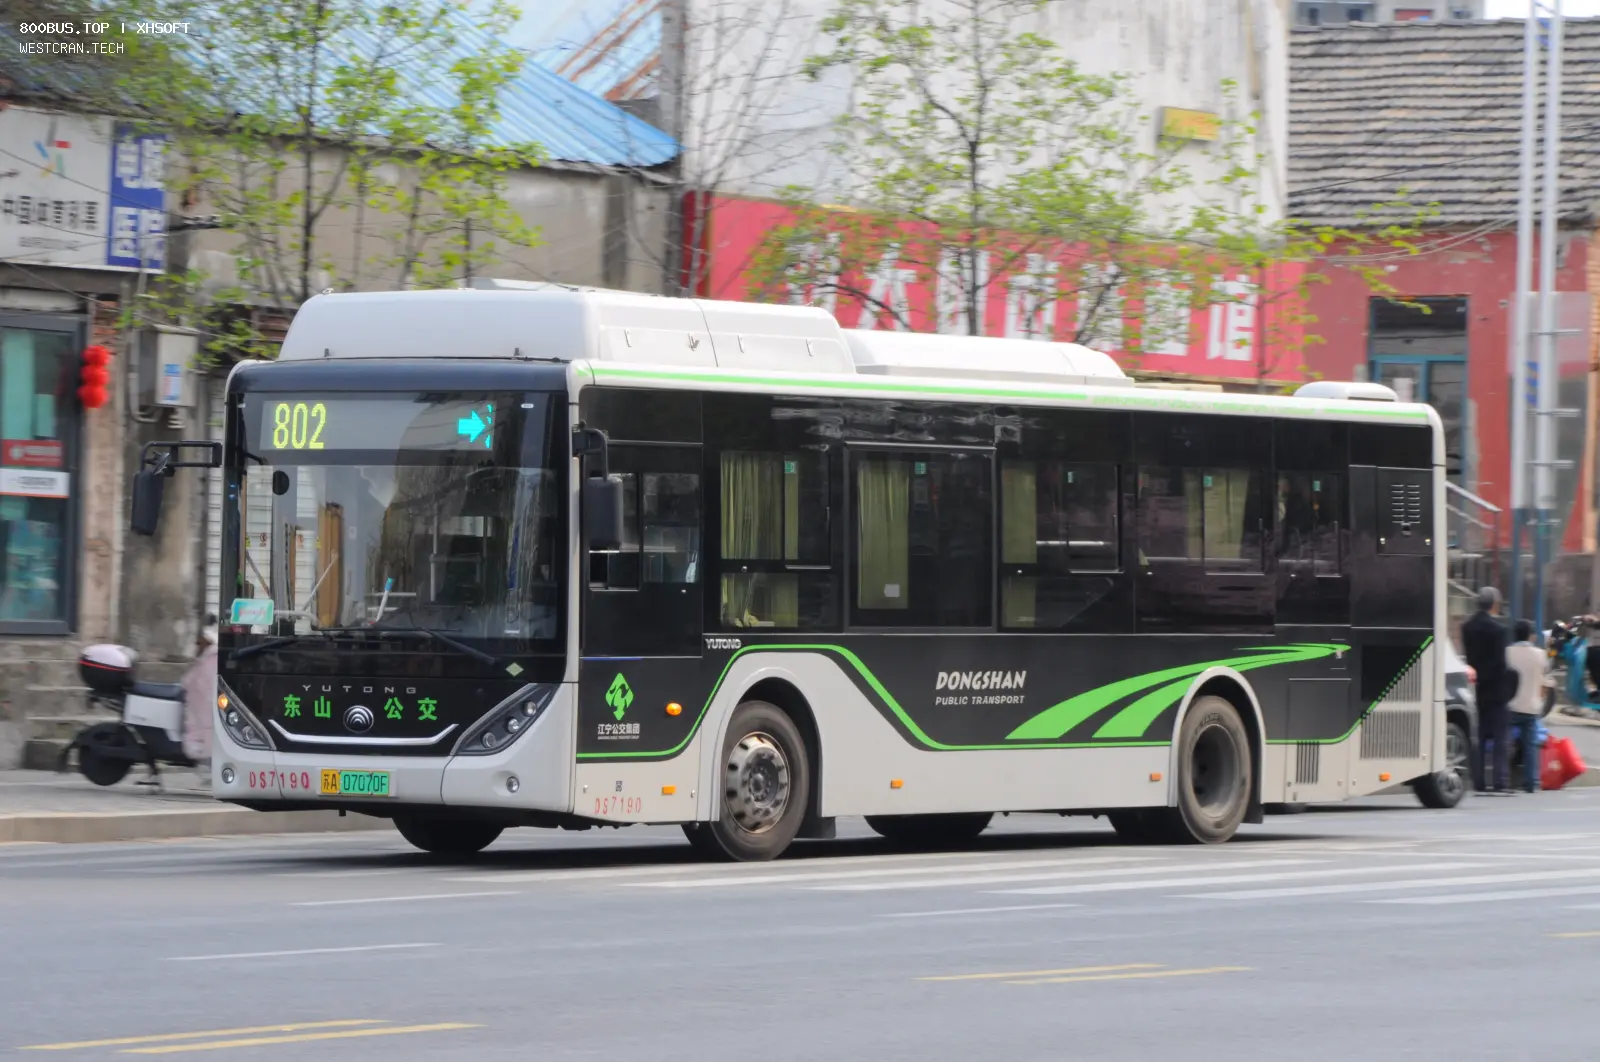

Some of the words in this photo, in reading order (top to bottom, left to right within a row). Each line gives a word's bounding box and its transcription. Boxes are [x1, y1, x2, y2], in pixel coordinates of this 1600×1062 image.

[273, 403, 325, 449] 802
[706, 639, 742, 649] YUTONG
[936, 671, 1026, 690] DONGSHAN
[302, 684, 416, 694] YUTONG
[935, 696, 969, 706] PUBLIC
[971, 695, 1025, 705] TRANSPORT
[597, 724, 640, 734] 江宁公交集团
[249, 771, 309, 789] DS7190
[595, 797, 641, 814] DS7190
